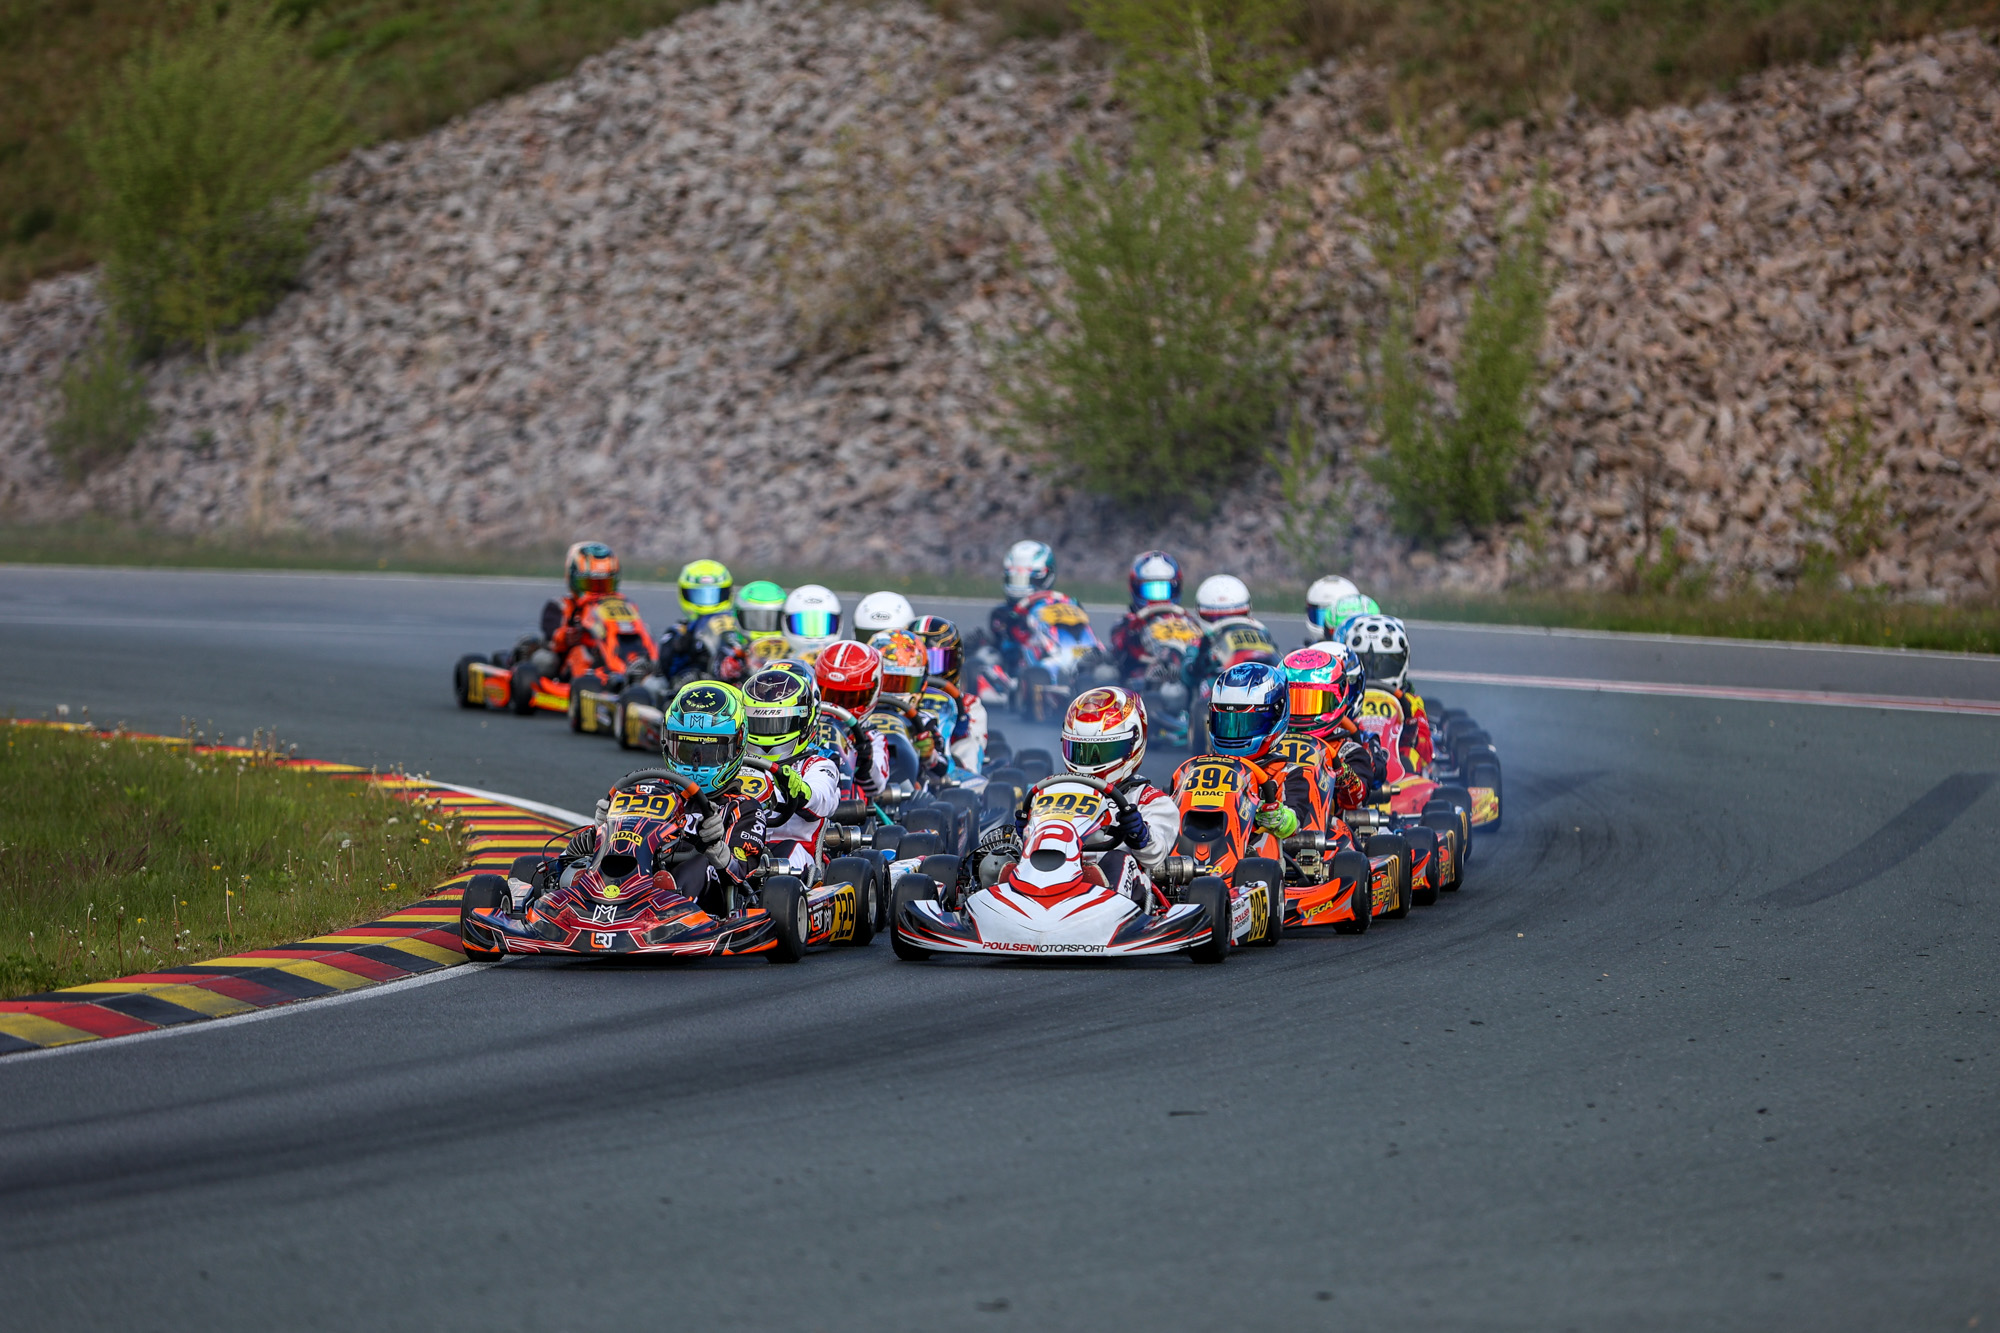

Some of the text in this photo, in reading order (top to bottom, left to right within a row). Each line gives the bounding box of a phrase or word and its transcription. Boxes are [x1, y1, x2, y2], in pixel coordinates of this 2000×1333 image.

[1184, 767, 1239, 792] 394
[610, 795, 670, 817] 329
[1036, 794, 1100, 816] 395
[611, 831, 641, 844] ADAC
[1303, 900, 1334, 919] VEGA
[590, 932, 617, 949] LRT
